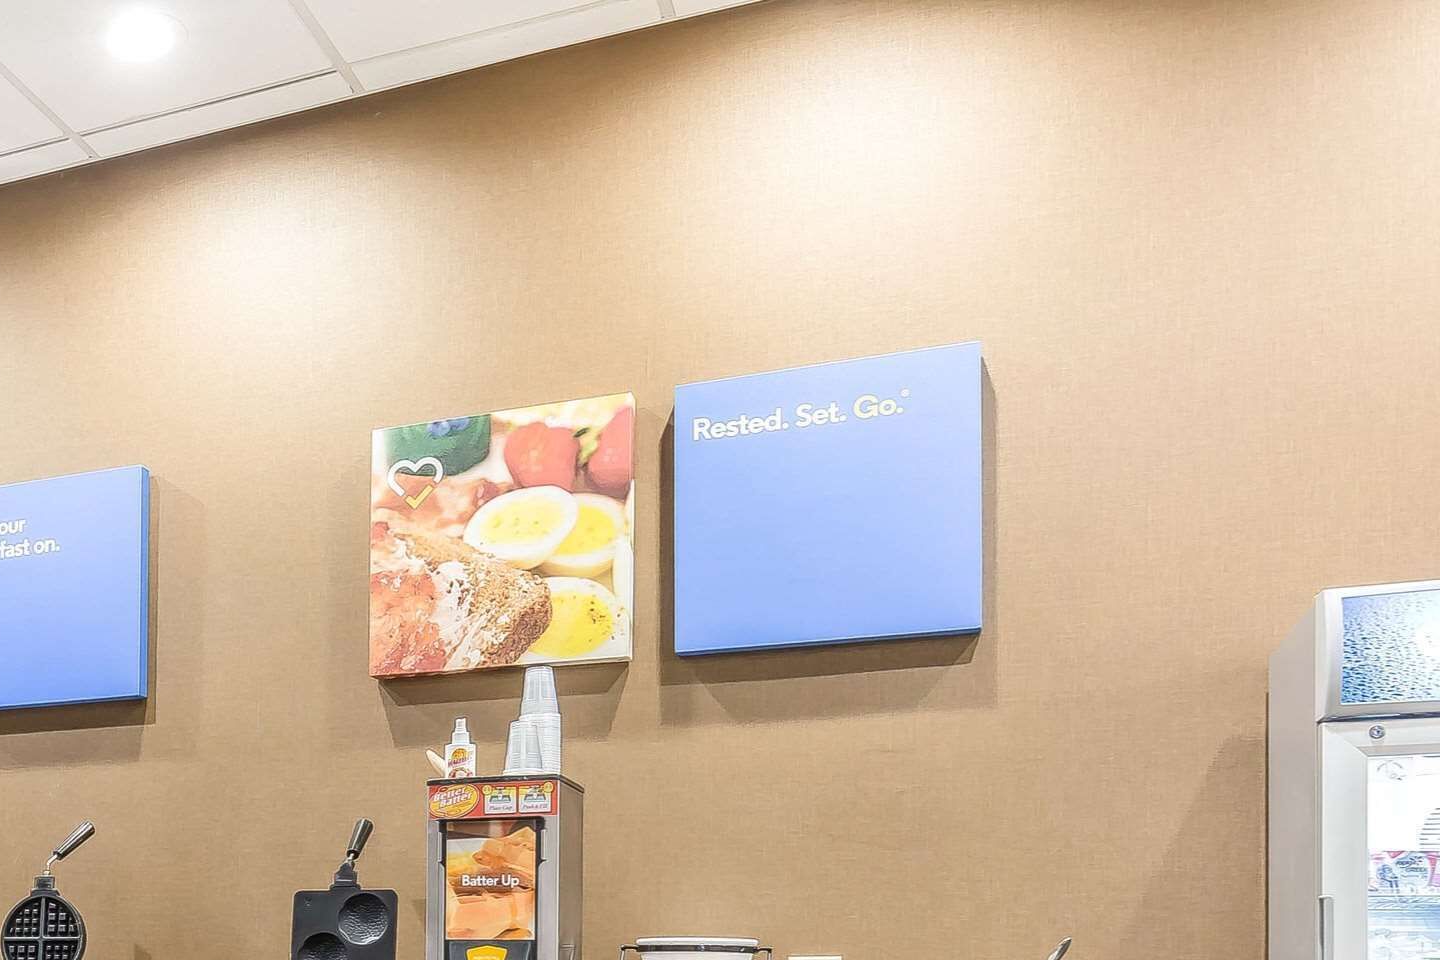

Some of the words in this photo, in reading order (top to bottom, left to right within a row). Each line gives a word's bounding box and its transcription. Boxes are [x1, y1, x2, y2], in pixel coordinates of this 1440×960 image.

[692, 407, 789, 441] Rested.
[795, 402, 848, 428] Set.
[33, 539, 61, 554] on.
[461, 875, 498, 887] Batter
[501, 875, 520, 889] Up
